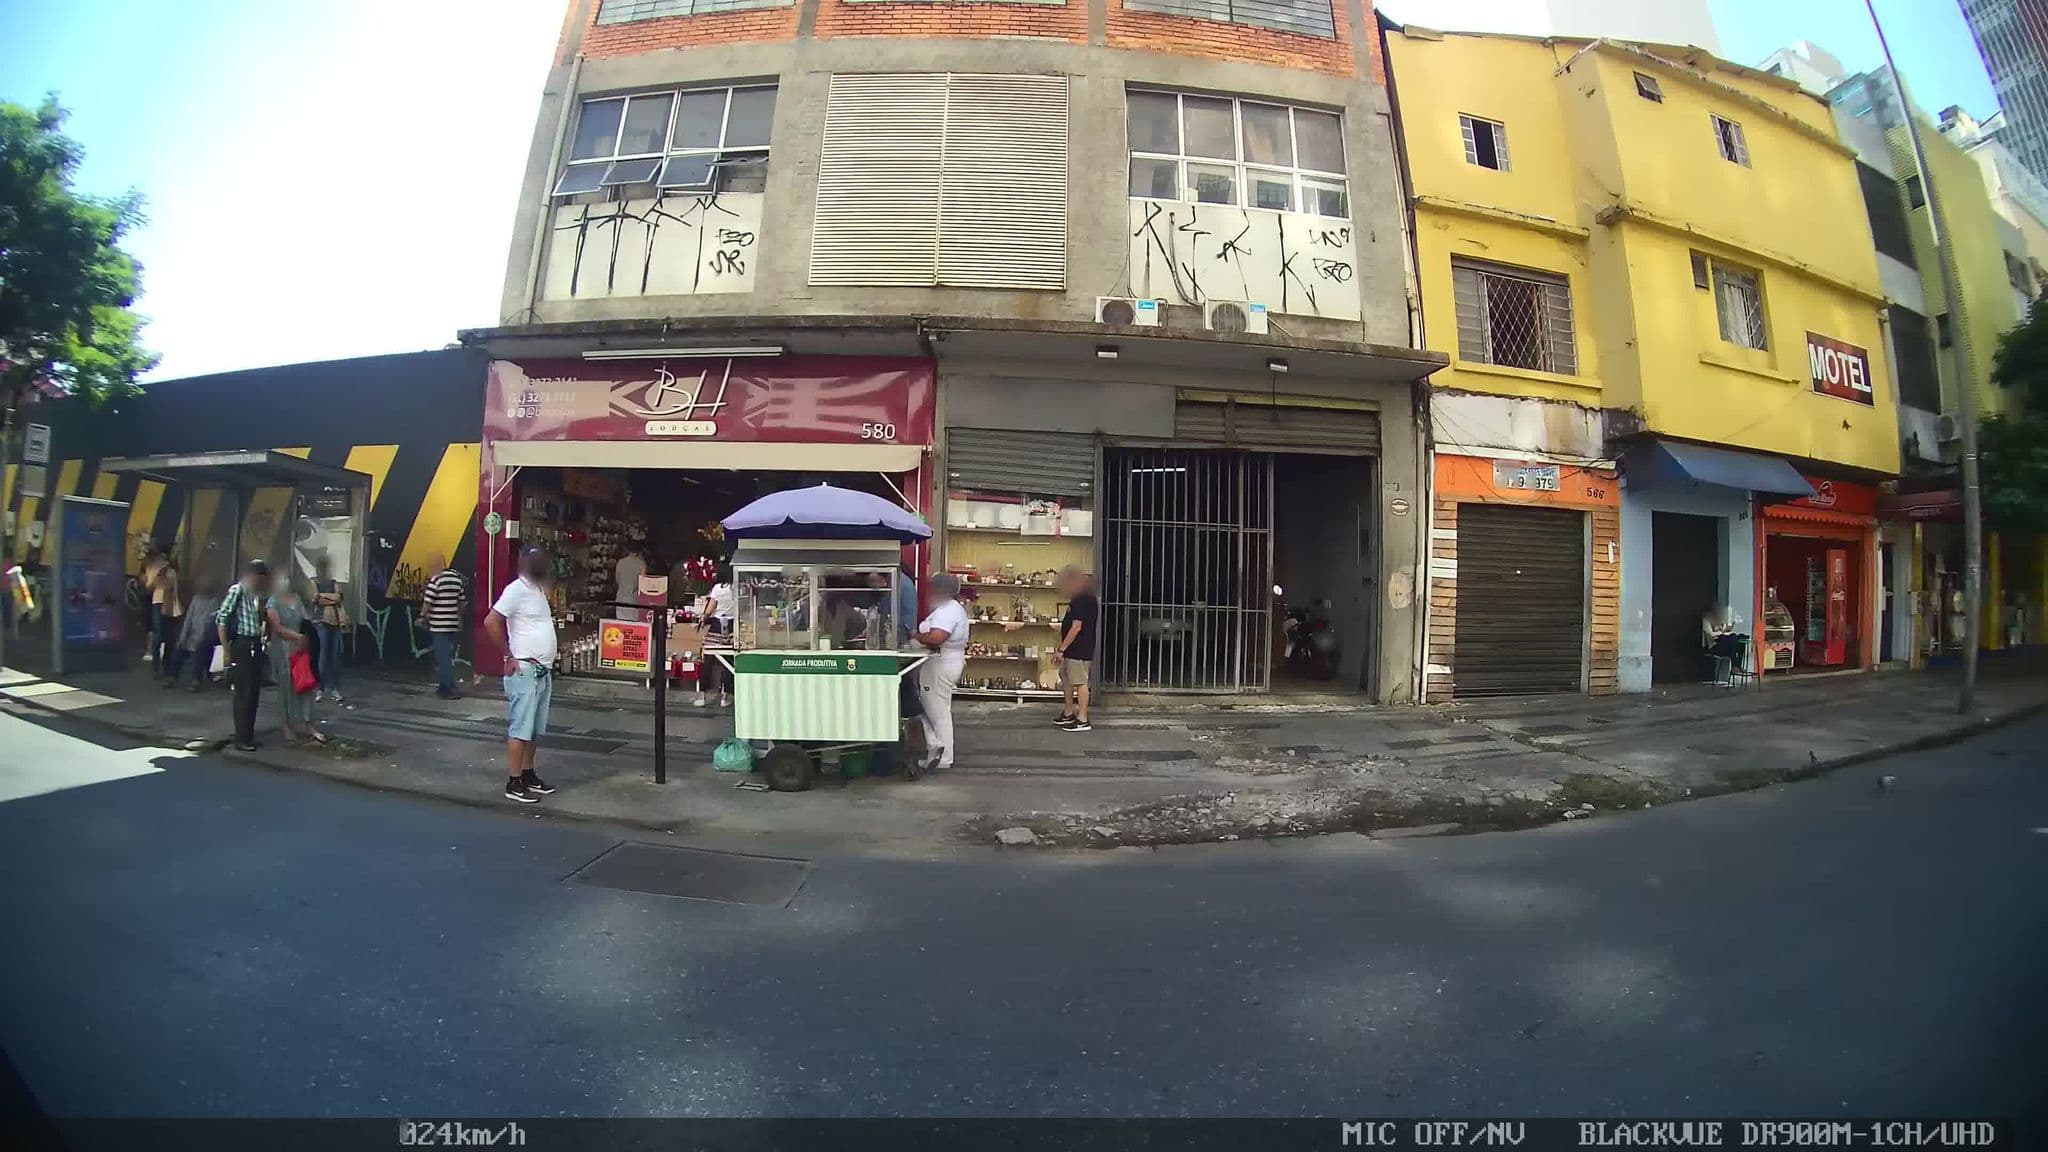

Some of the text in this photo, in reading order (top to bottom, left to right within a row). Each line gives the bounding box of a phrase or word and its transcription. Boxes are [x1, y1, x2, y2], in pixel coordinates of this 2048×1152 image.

[1808, 343, 1872, 393] MOTEL
[635, 358, 732, 421] BH
[860, 422, 896, 439] 580
[1586, 486, 1605, 500] 566
